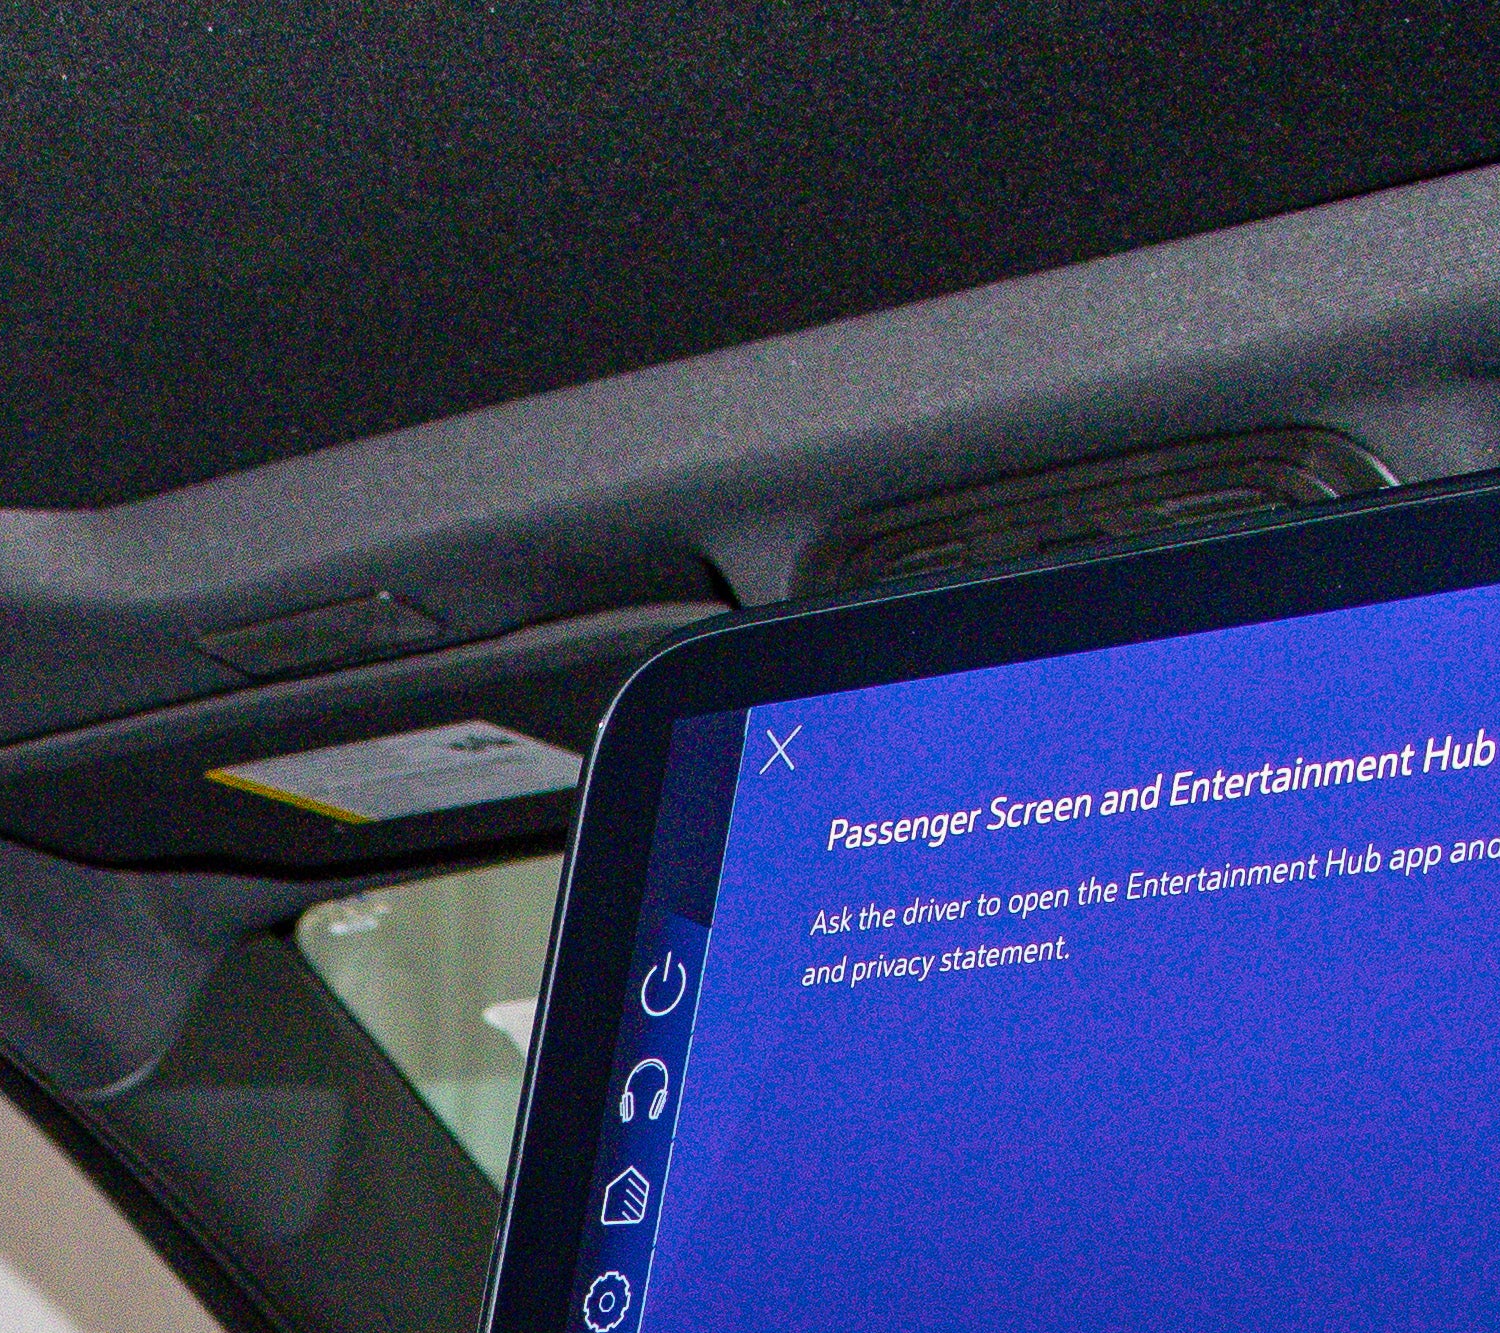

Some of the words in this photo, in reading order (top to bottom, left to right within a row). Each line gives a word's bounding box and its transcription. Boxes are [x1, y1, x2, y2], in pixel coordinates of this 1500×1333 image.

[826, 808, 982, 851] Passenger
[985, 795, 1093, 832] Screen
[1098, 773, 1164, 816] and
[1169, 743, 1417, 807] Entertainment
[1422, 728, 1497, 773] Hub
[809, 904, 853, 936] Ask
[858, 902, 898, 931] the
[902, 898, 972, 926] driver
[976, 894, 1002, 917] to
[1007, 889, 1070, 920] open
[1077, 876, 1119, 906] the
[1125, 853, 1320, 900] Entertainment
[1324, 843, 1383, 877] Hub
[1388, 843, 1443, 876] app
[801, 956, 847, 988] and
[850, 953, 936, 989] privacy
[938, 935, 1071, 973] statement.
